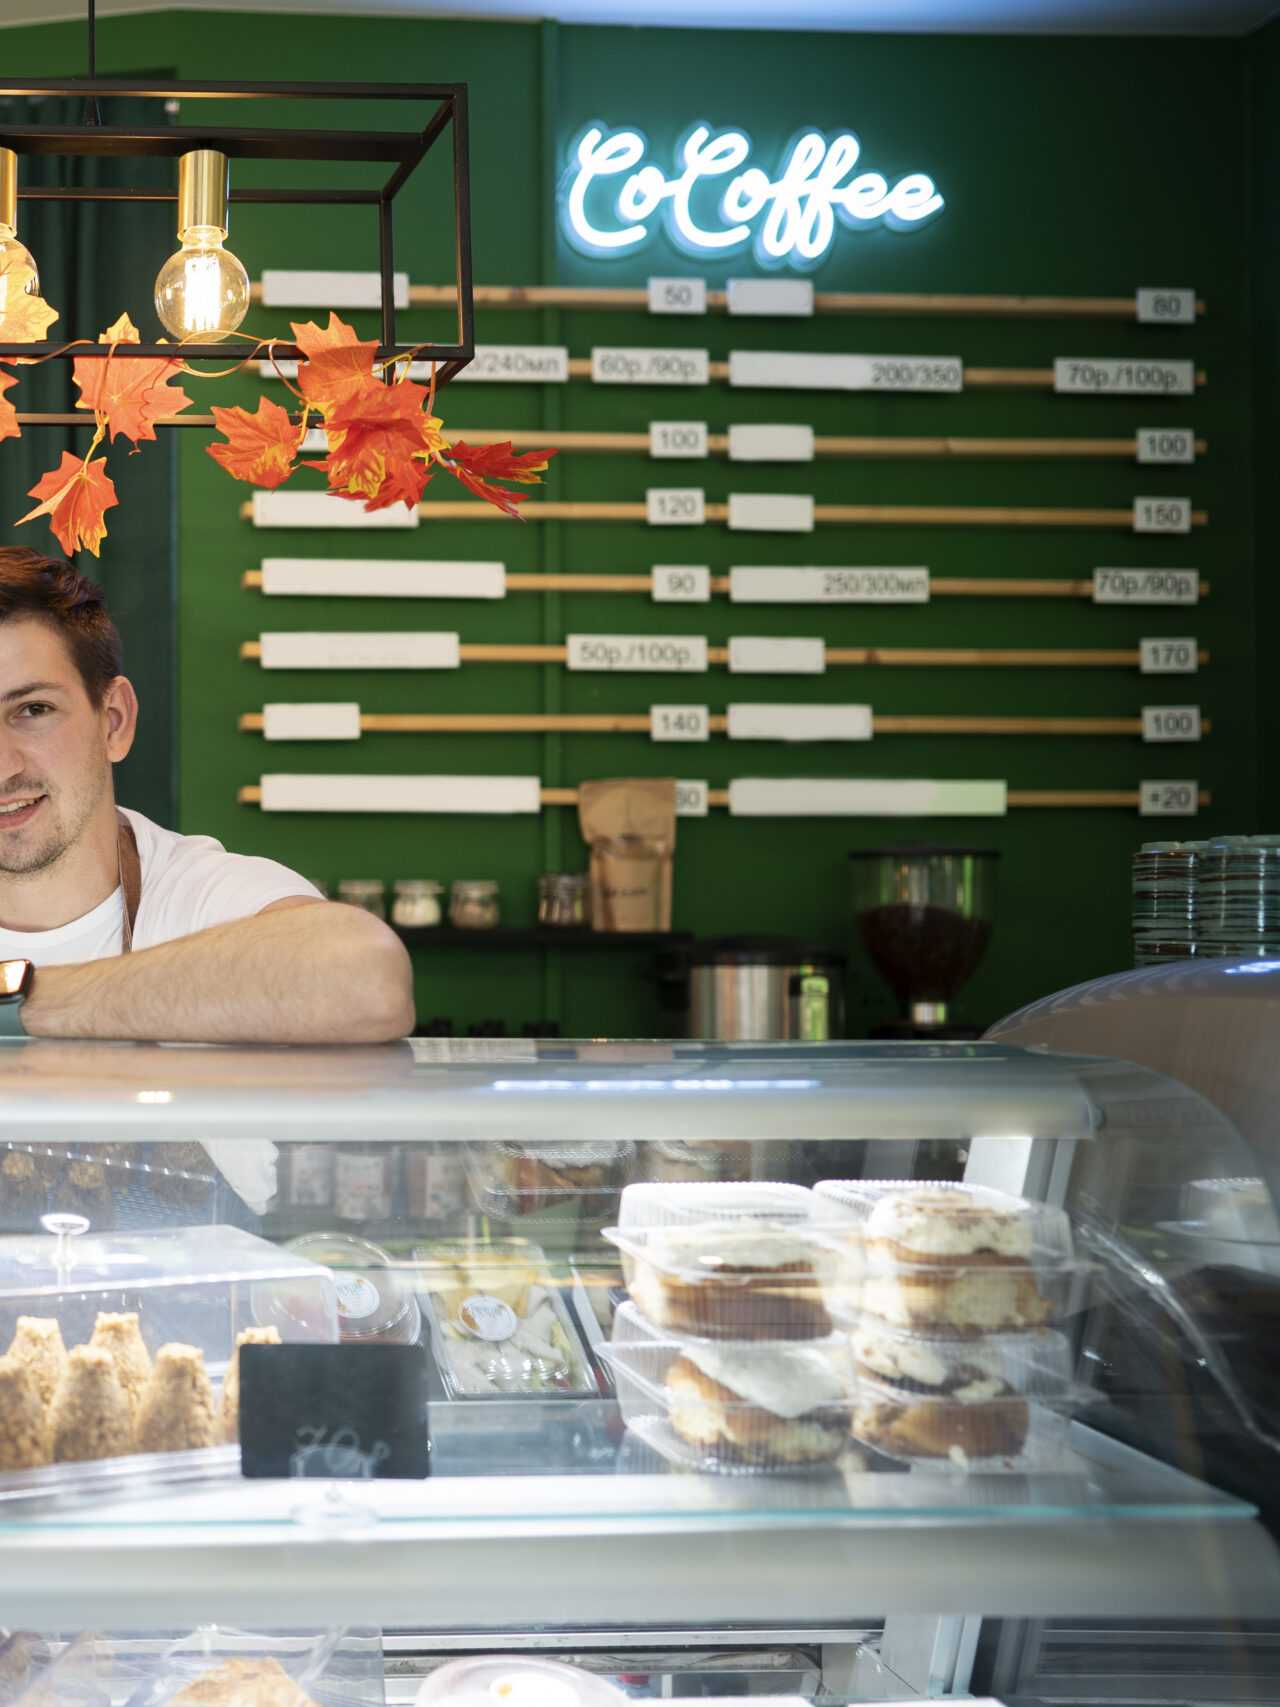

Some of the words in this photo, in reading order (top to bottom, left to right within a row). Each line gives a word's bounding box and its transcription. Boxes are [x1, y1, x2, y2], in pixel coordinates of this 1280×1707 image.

[566, 125, 945, 261] CoCoffee
[663, 284, 693, 306] 50
[871, 361, 959, 387] 200/350
[659, 429, 700, 450] 100
[1146, 434, 1188, 457] 100
[657, 495, 697, 517] 120
[1142, 503, 1183, 526] 150
[667, 573, 695, 595] 90
[1149, 644, 1190, 667] 170
[660, 712, 701, 735] 140
[1152, 711, 1193, 736] 100
[1149, 785, 1192, 810] +20
